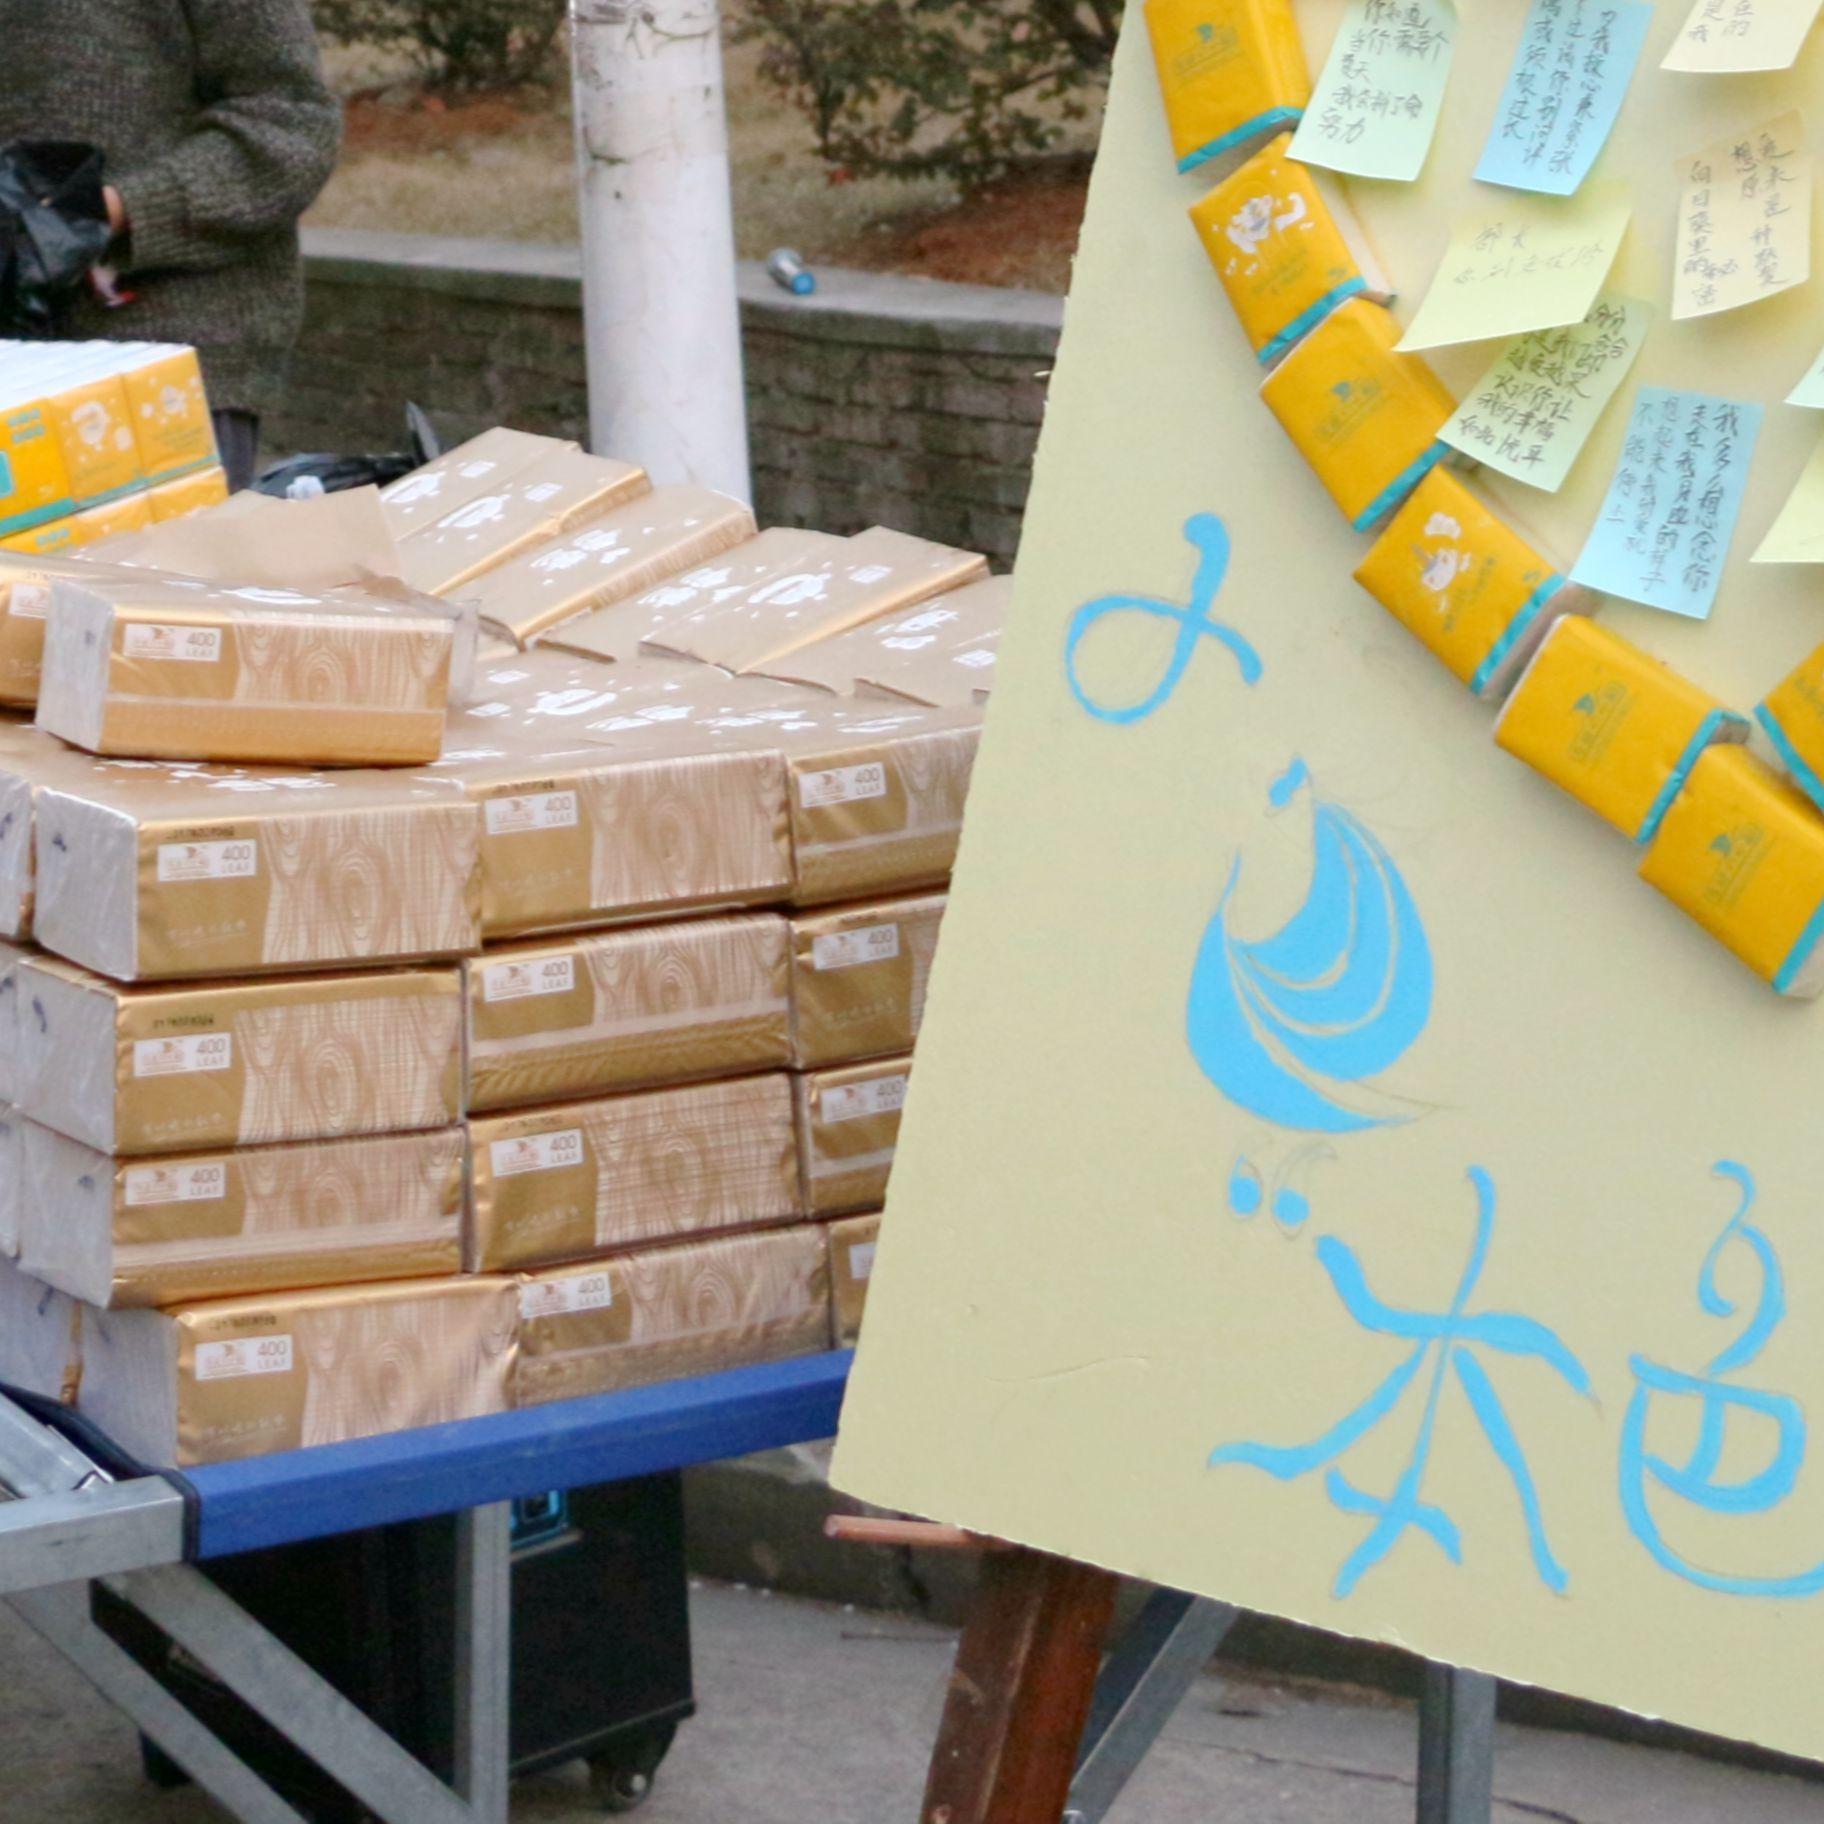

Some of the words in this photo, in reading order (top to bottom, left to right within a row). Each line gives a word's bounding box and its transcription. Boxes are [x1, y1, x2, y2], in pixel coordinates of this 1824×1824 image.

[1317, 107, 1365, 143] 努力
[187, 632, 216, 649] 400
[544, 794, 573, 813] 400
[221, 844, 251, 861] 400
[543, 960, 568, 976] 400
[197, 1038, 225, 1054] 400
[549, 1134, 577, 1151] 400
[190, 1167, 220, 1184] 400
[578, 1278, 605, 1294] 400
[257, 1339, 288, 1356] 400
